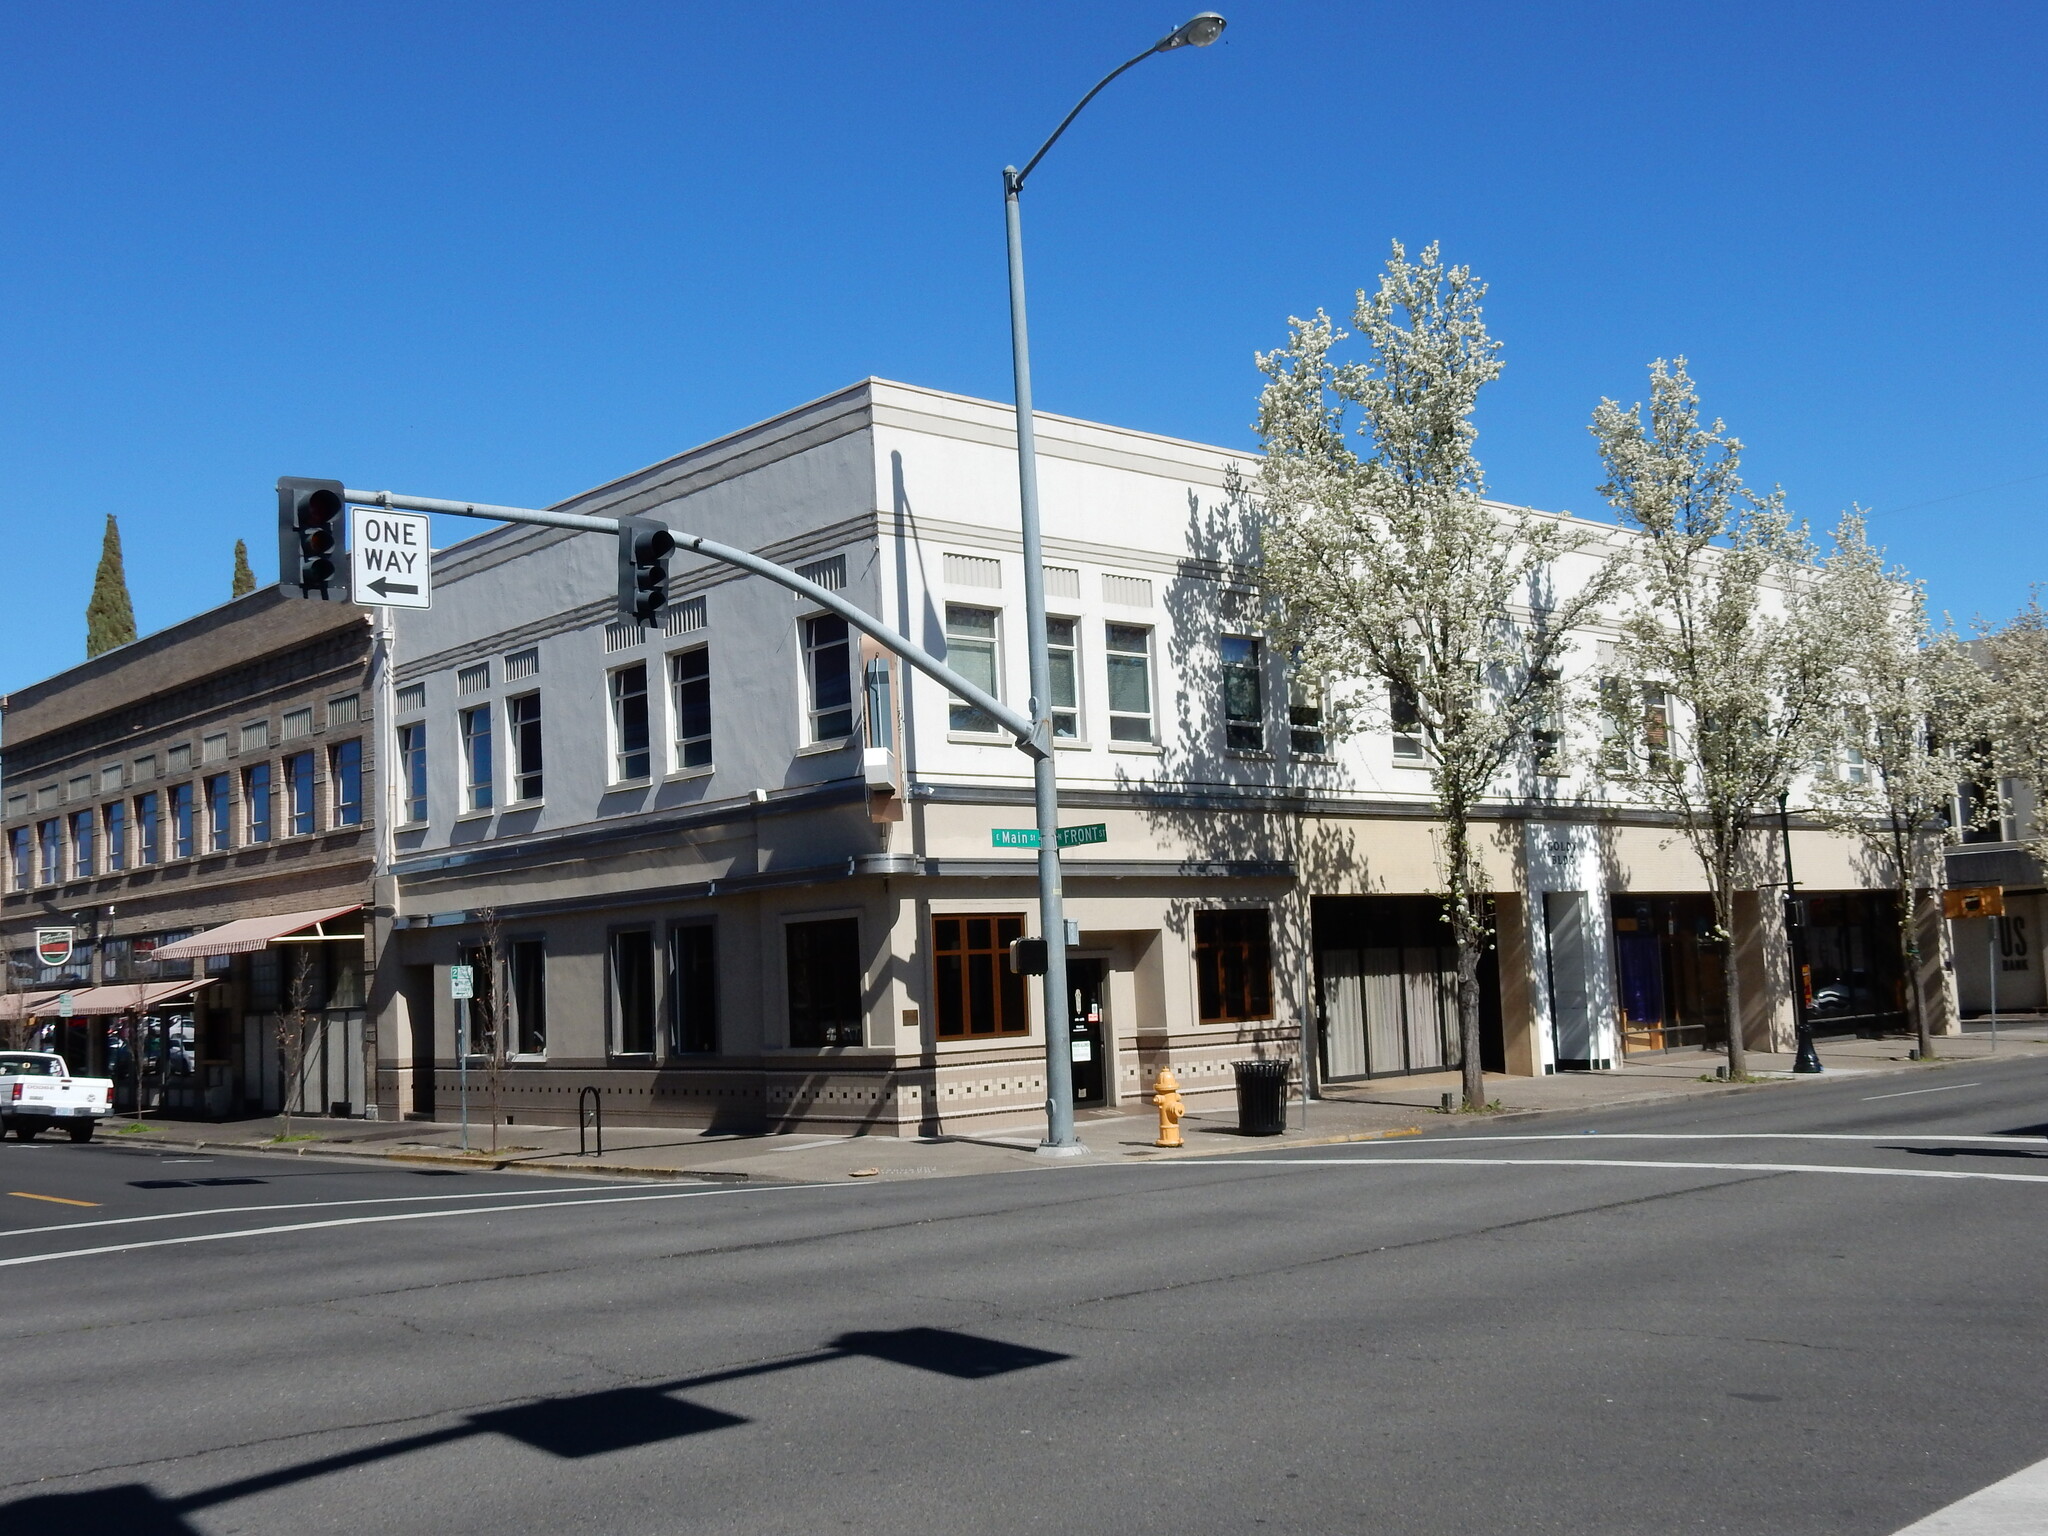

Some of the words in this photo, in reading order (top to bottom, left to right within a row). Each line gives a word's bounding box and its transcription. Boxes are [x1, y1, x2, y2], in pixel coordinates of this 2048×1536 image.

[365, 519, 417, 546] ONE
[364, 547, 418, 574] WAY
[1002, 831, 1028, 844] Main
[1063, 827, 1098, 844] FRONT
[1552, 855, 1575, 865] BLDG
[1999, 916, 2027, 957] US
